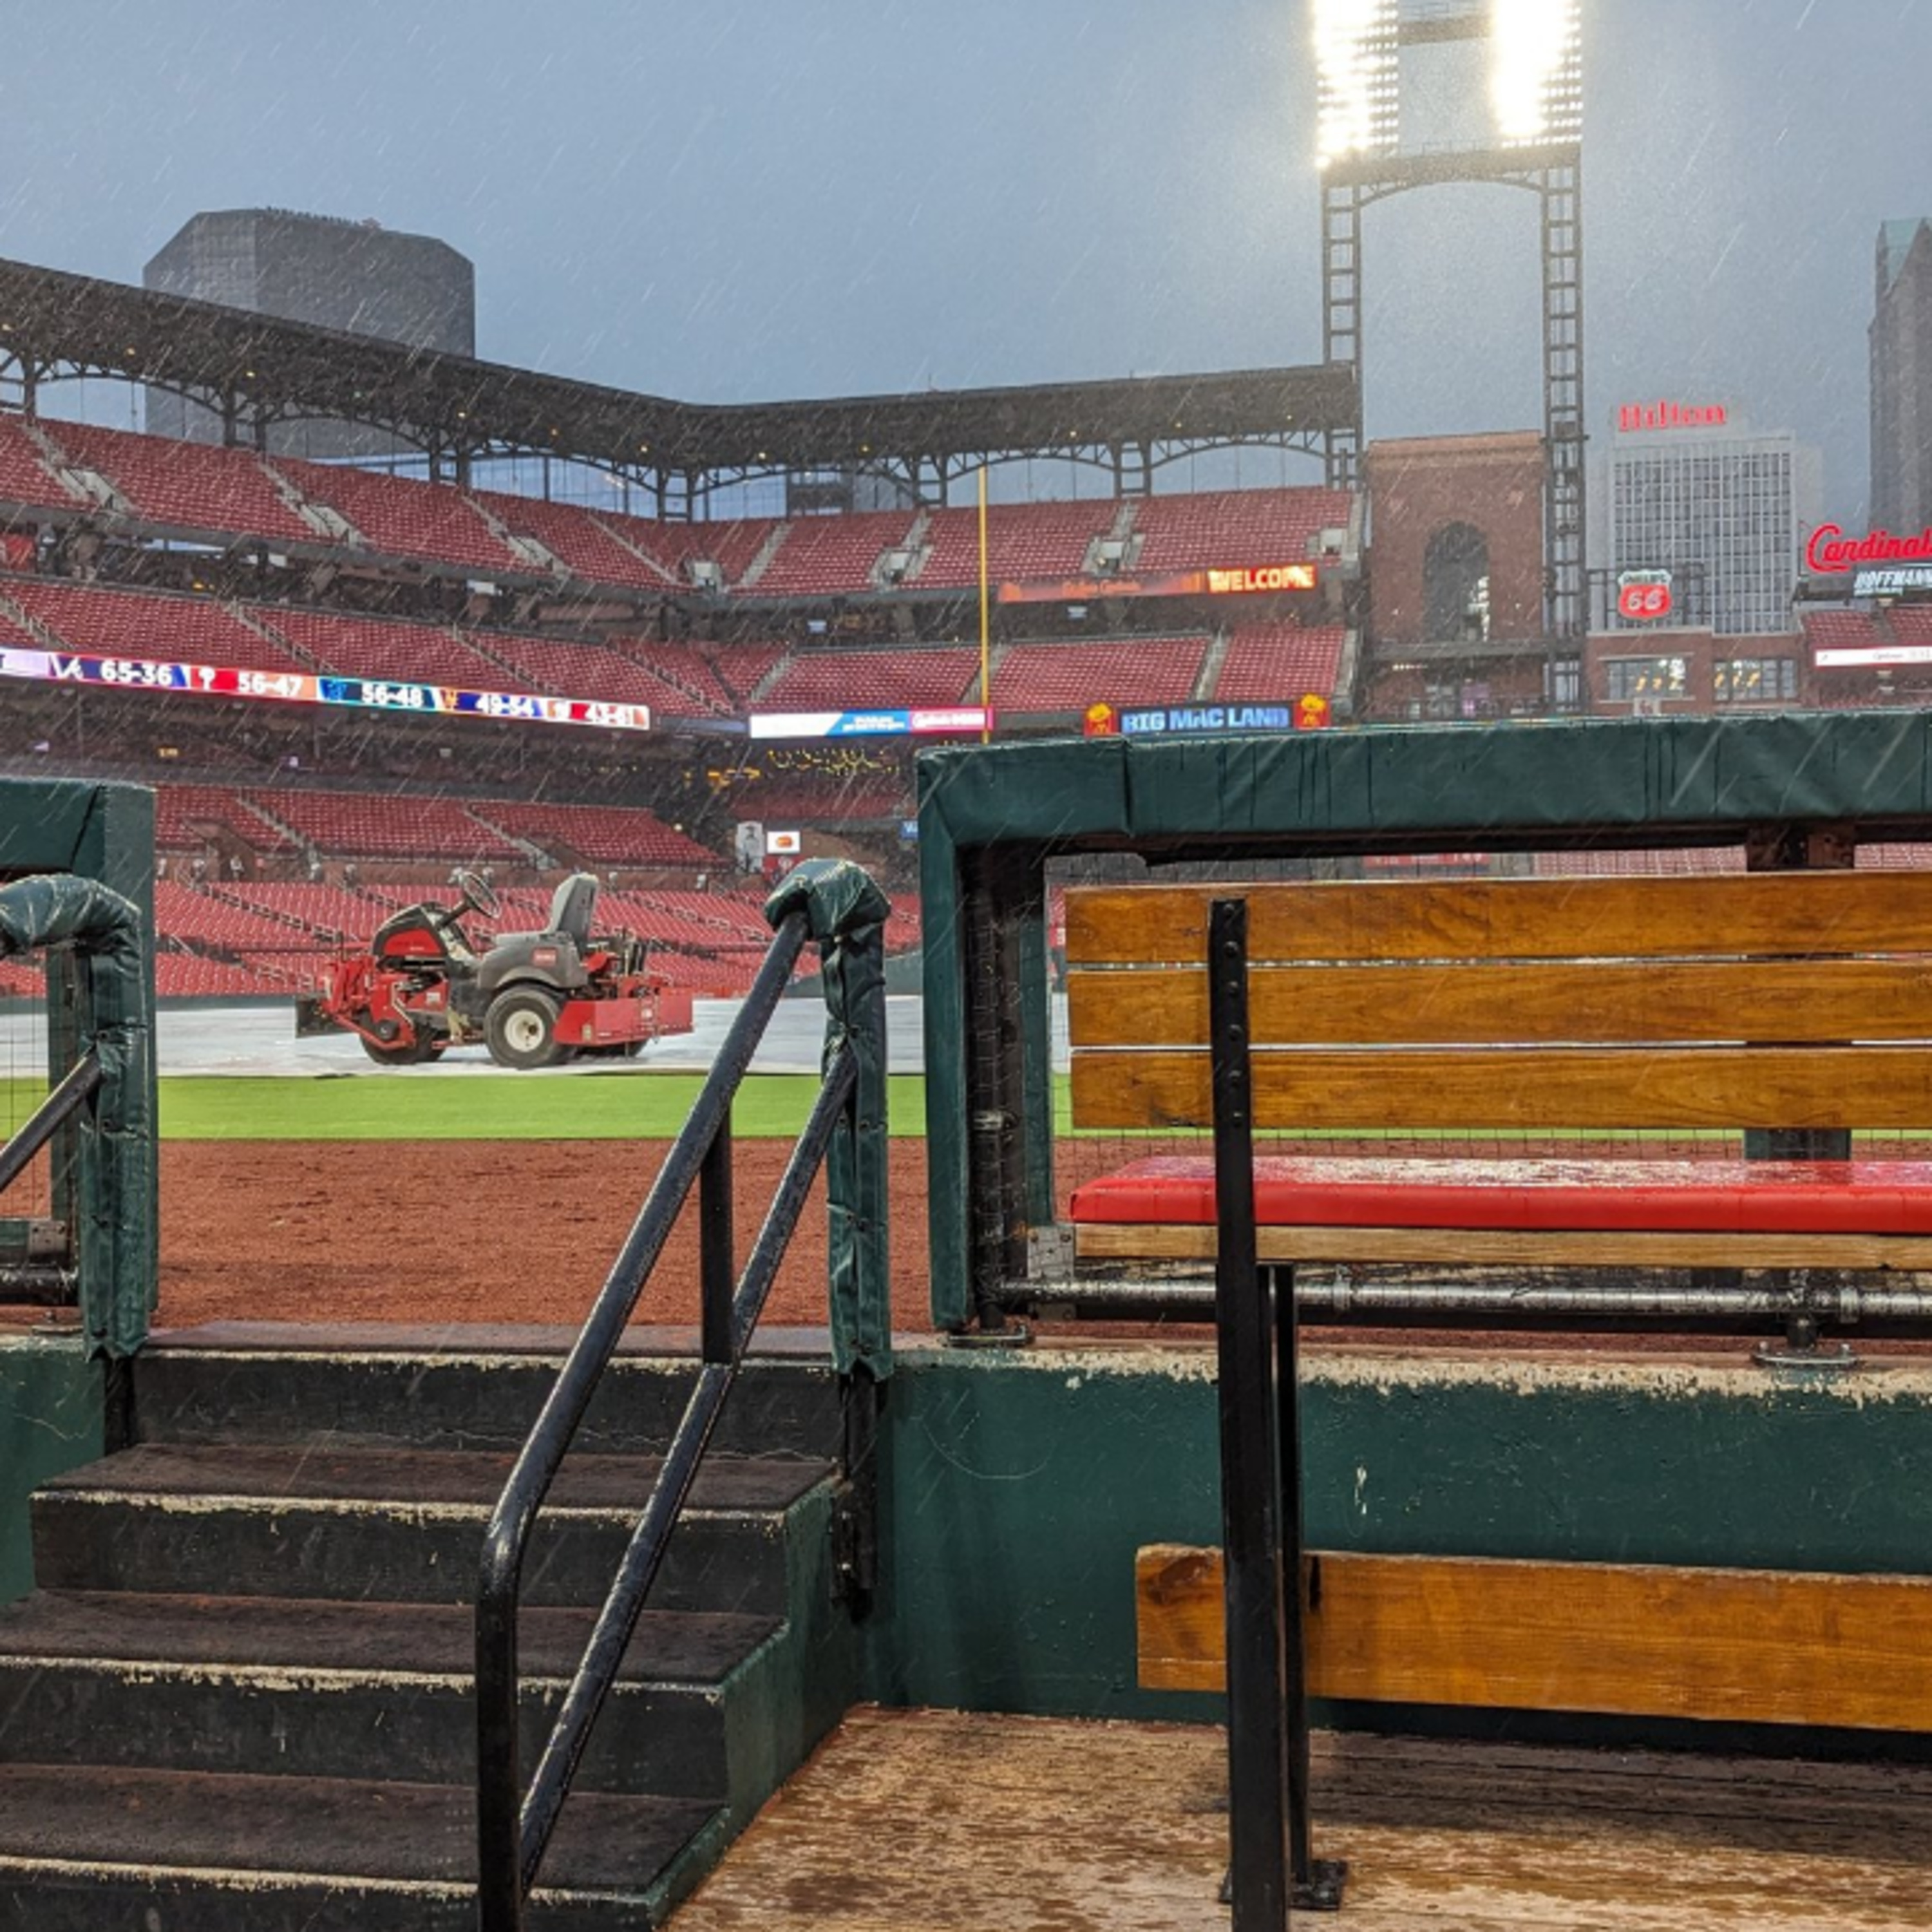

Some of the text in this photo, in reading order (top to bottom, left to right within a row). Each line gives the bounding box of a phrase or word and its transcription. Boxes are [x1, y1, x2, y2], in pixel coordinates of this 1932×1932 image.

[1619, 399, 1727, 431] Hilton
[1627, 590, 1665, 611] 66
[100, 659, 172, 687] 65-36
[238, 672, 303, 697] 56-47
[1122, 707, 1289, 734] BIG MAC LAND
